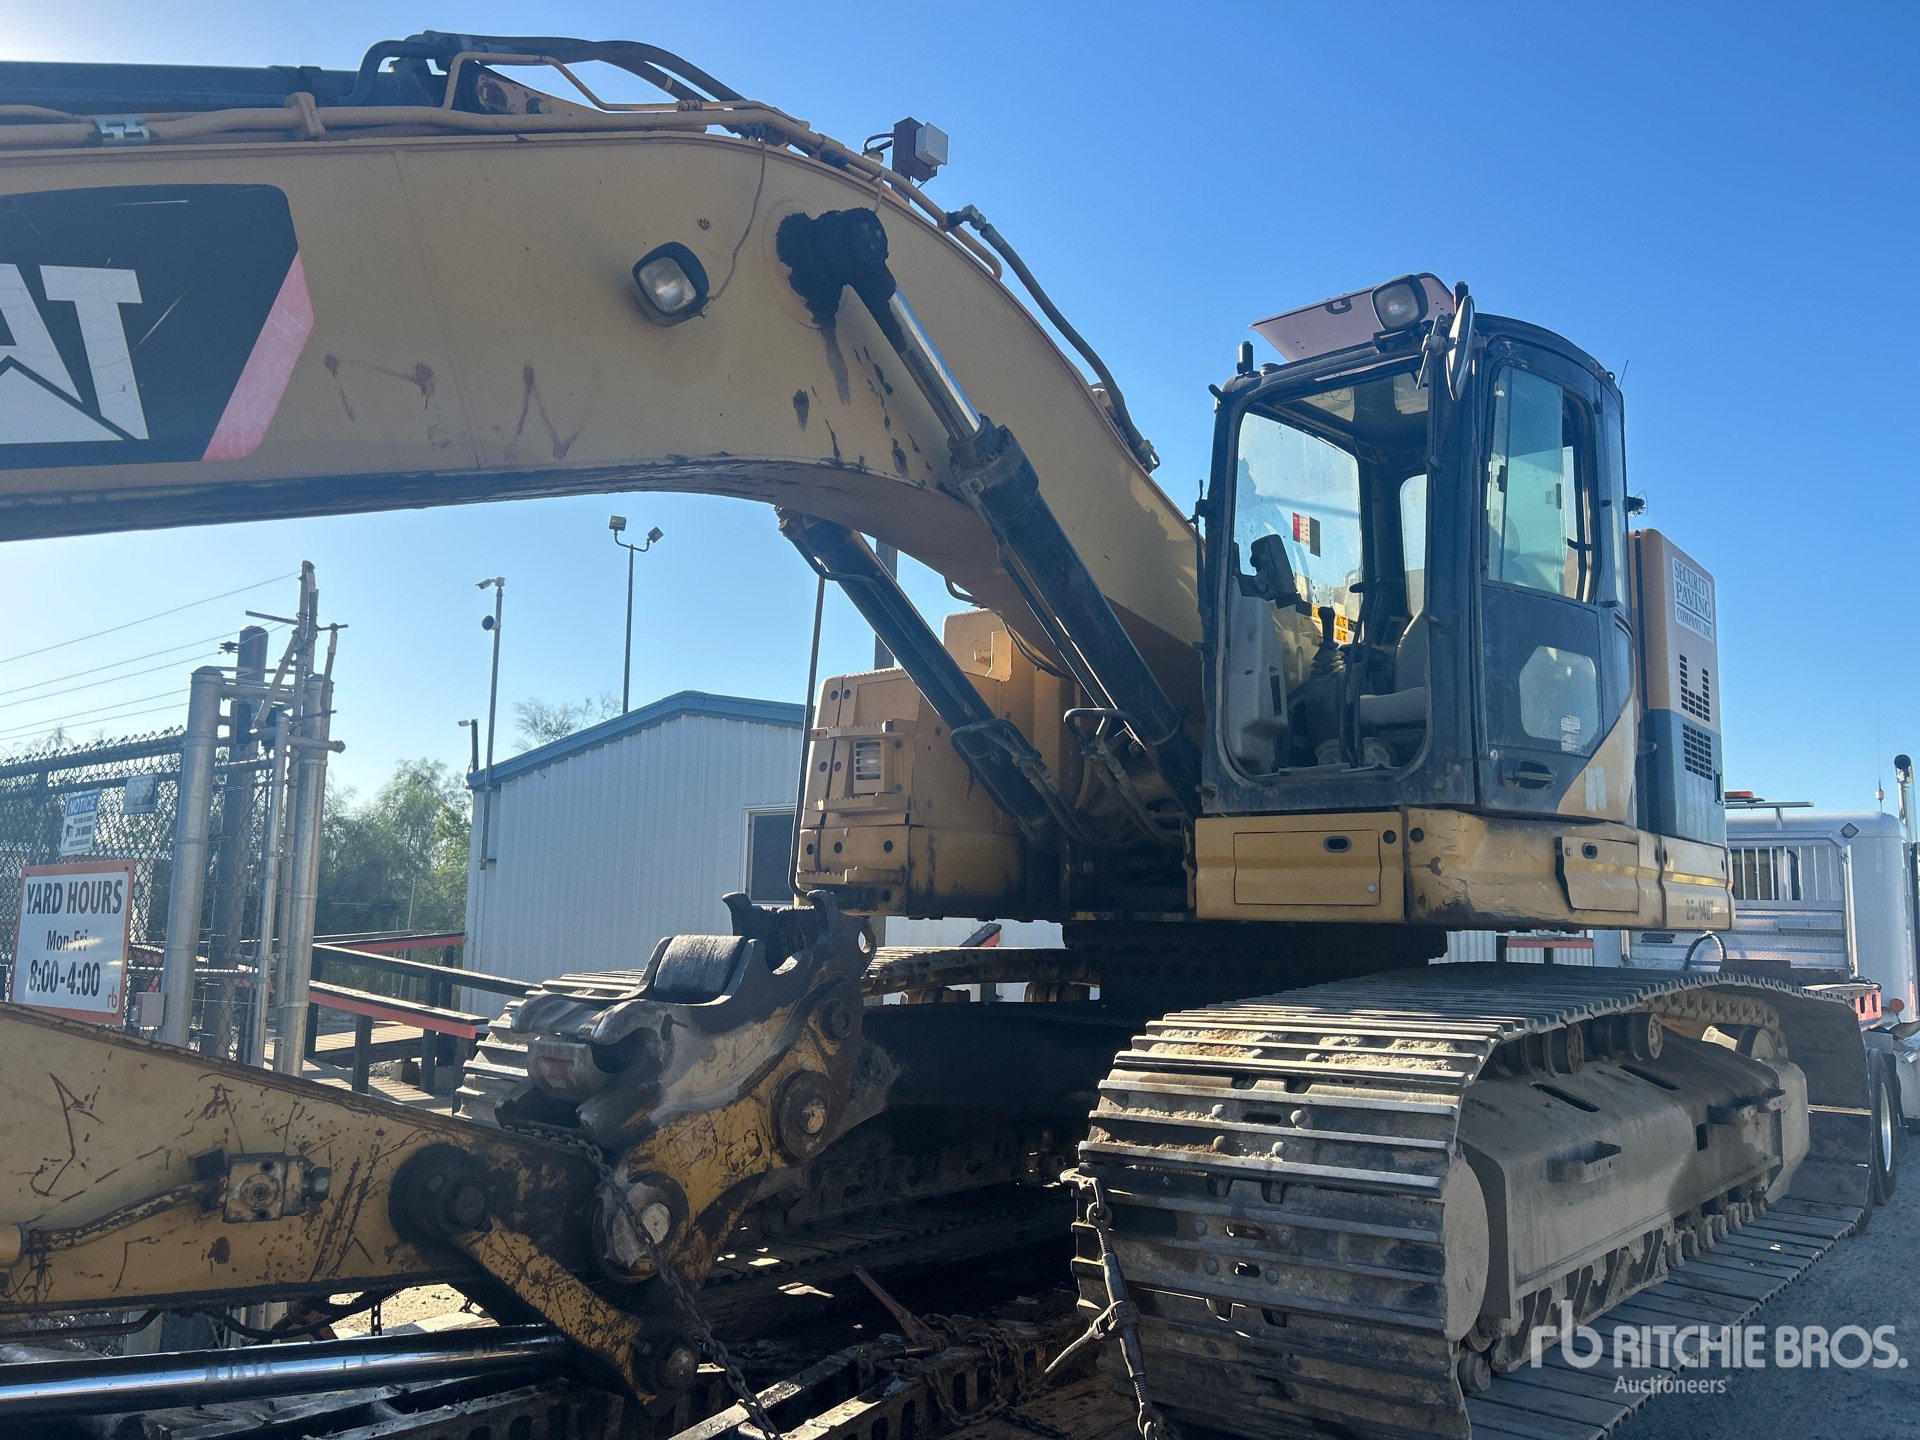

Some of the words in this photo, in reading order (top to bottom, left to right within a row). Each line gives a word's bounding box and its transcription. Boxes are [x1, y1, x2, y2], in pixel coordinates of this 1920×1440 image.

[1674, 560, 1710, 599] SECURITY
[1676, 580, 1711, 619] PAVING
[68, 795, 97, 815] NOTICE
[26, 882, 63, 915] YARD
[66, 879, 123, 915] HOURS
[46, 929, 88, 951] Mon-Fri
[29, 959, 100, 997] 8:00-4:00
[106, 985, 118, 1009] rb
